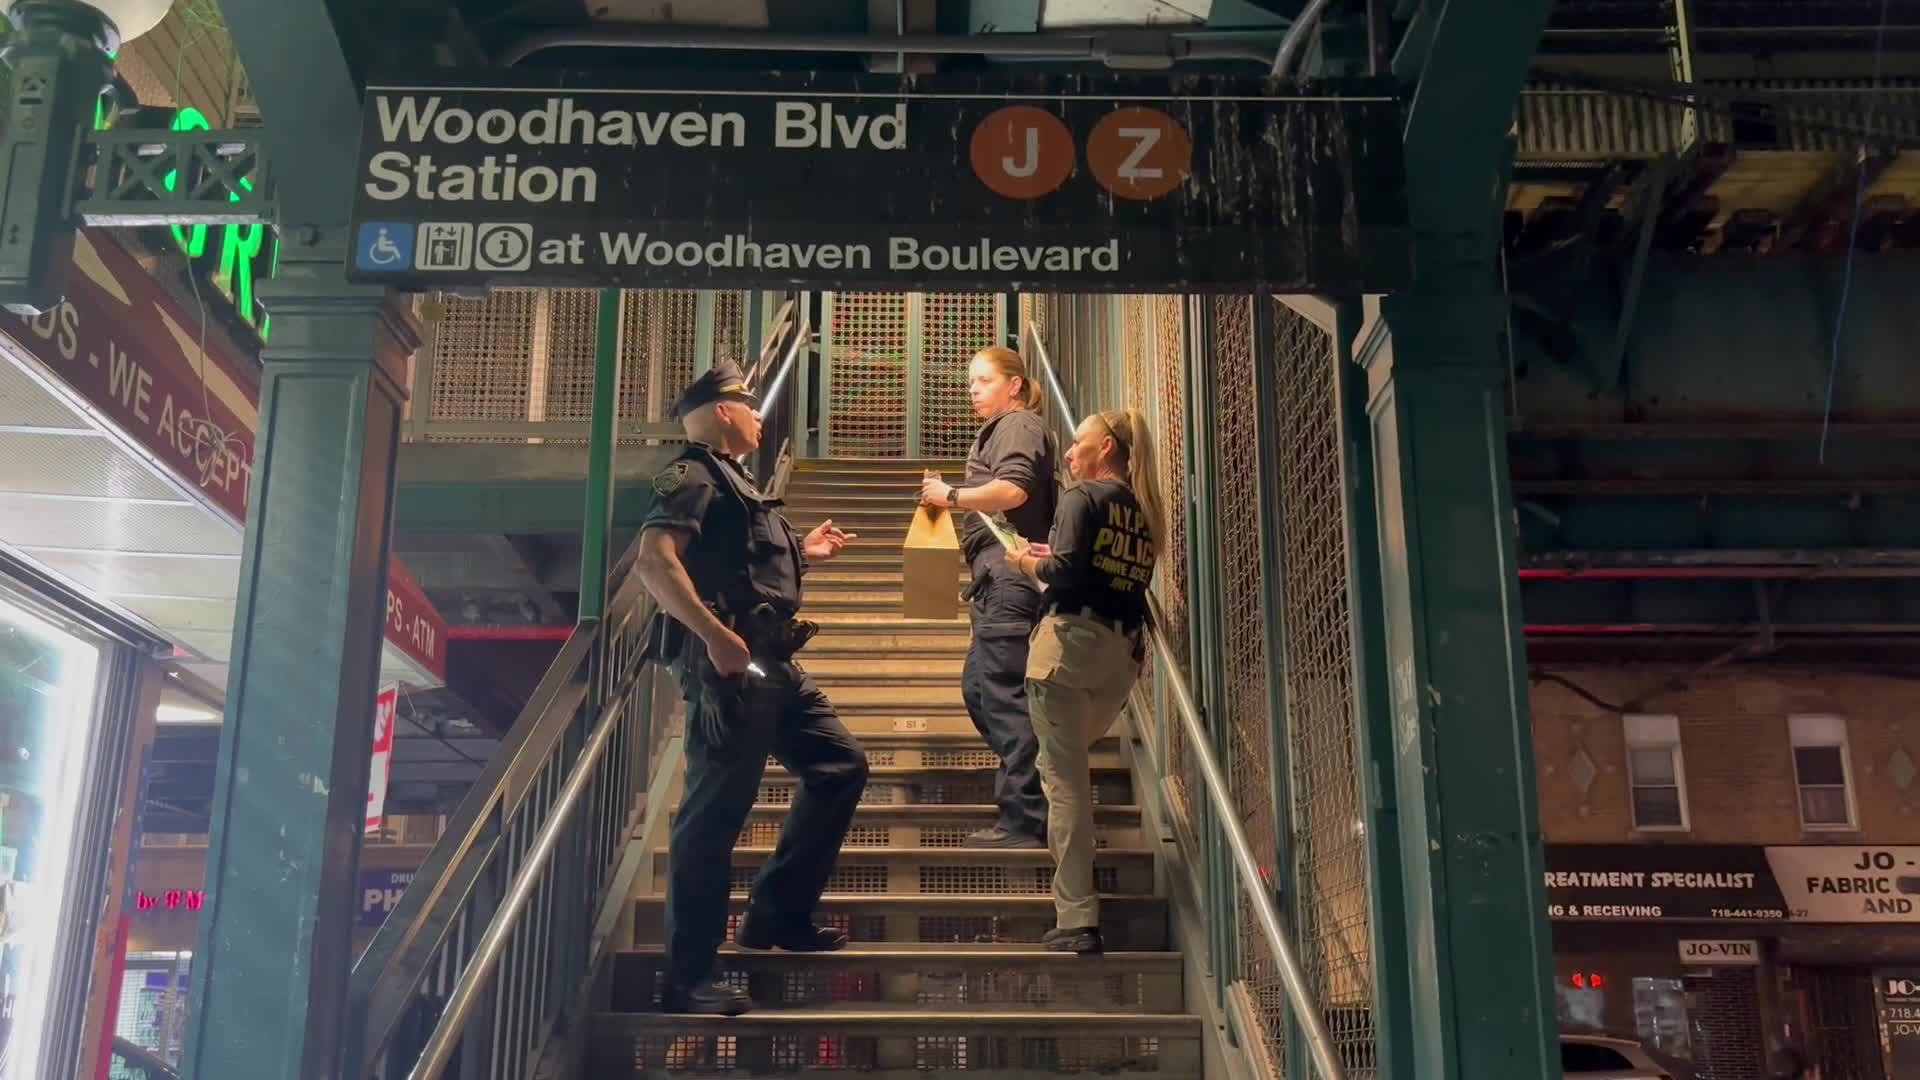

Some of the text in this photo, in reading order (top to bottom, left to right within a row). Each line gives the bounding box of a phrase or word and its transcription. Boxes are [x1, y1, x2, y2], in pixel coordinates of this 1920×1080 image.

[376, 96, 907, 151] Woodhaven Blvd
[1002, 127, 1040, 178] J
[1117, 127, 1163, 179] Z
[365, 150, 598, 203] Station
[538, 231, 1120, 272] at Woodhaven Boulevard
[109, 339, 153, 425] WE
[157, 394, 254, 507] ACCEPT
[1093, 527, 1154, 567] POLIC
[411, 615, 435, 657] ATM
[1544, 871, 1755, 889] REATMENT SPECIALIST
[1854, 851, 1895, 871] JO
[1806, 877, 1891, 894] FABRIC
[1568, 905, 1579, 917] &
[1583, 905, 1662, 917] RECEIVING
[1863, 898, 1913, 914] AND
[1686, 943, 1752, 956] JO-VIN
